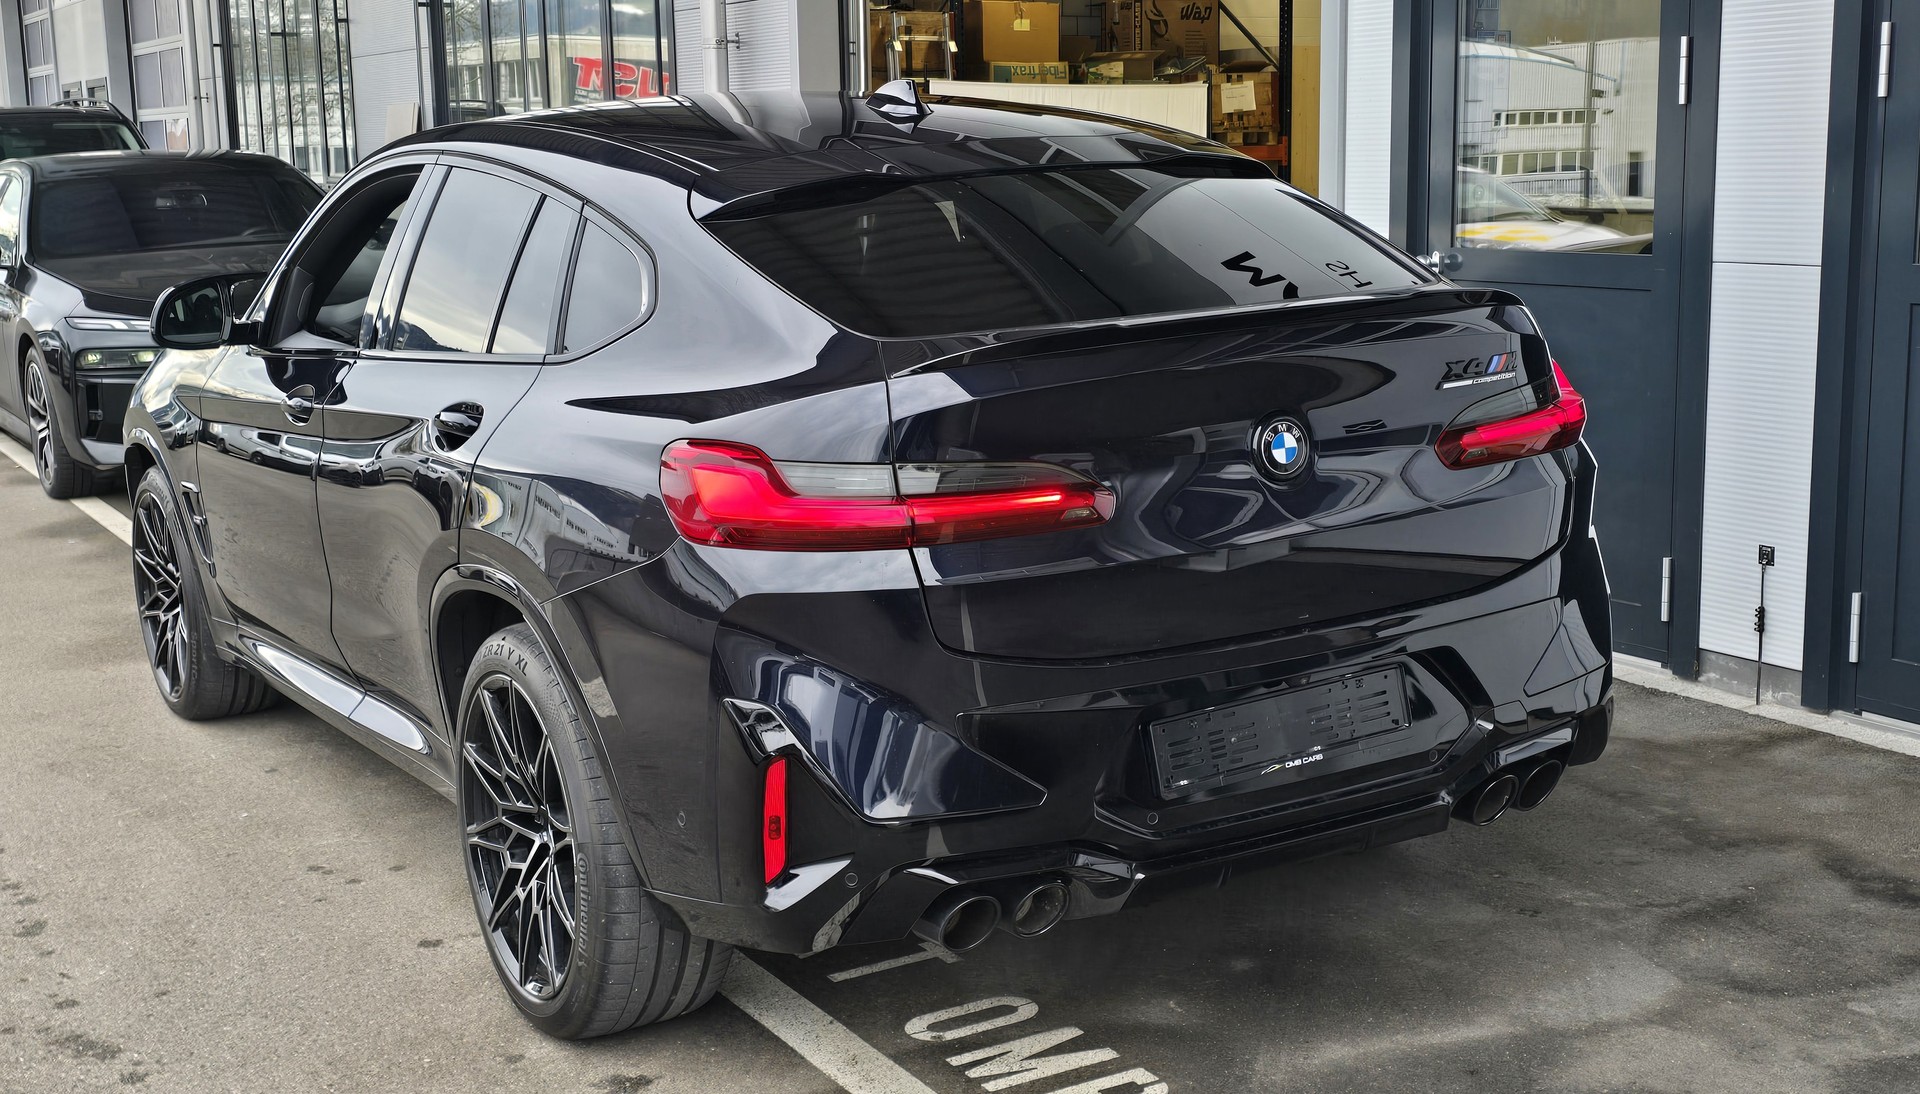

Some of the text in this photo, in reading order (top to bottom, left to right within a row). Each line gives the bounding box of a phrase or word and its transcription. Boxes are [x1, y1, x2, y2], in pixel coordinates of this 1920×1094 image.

[1180, 2, 1213, 24] Wap
[1011, 65, 1067, 79] Fiberfrax
[1265, 423, 1301, 441] BMW
[507, 647, 515, 660] Y
[515, 654, 528, 677] XL
[1302, 753, 1324, 764] CARS
[576, 853, 590, 959] Continental
